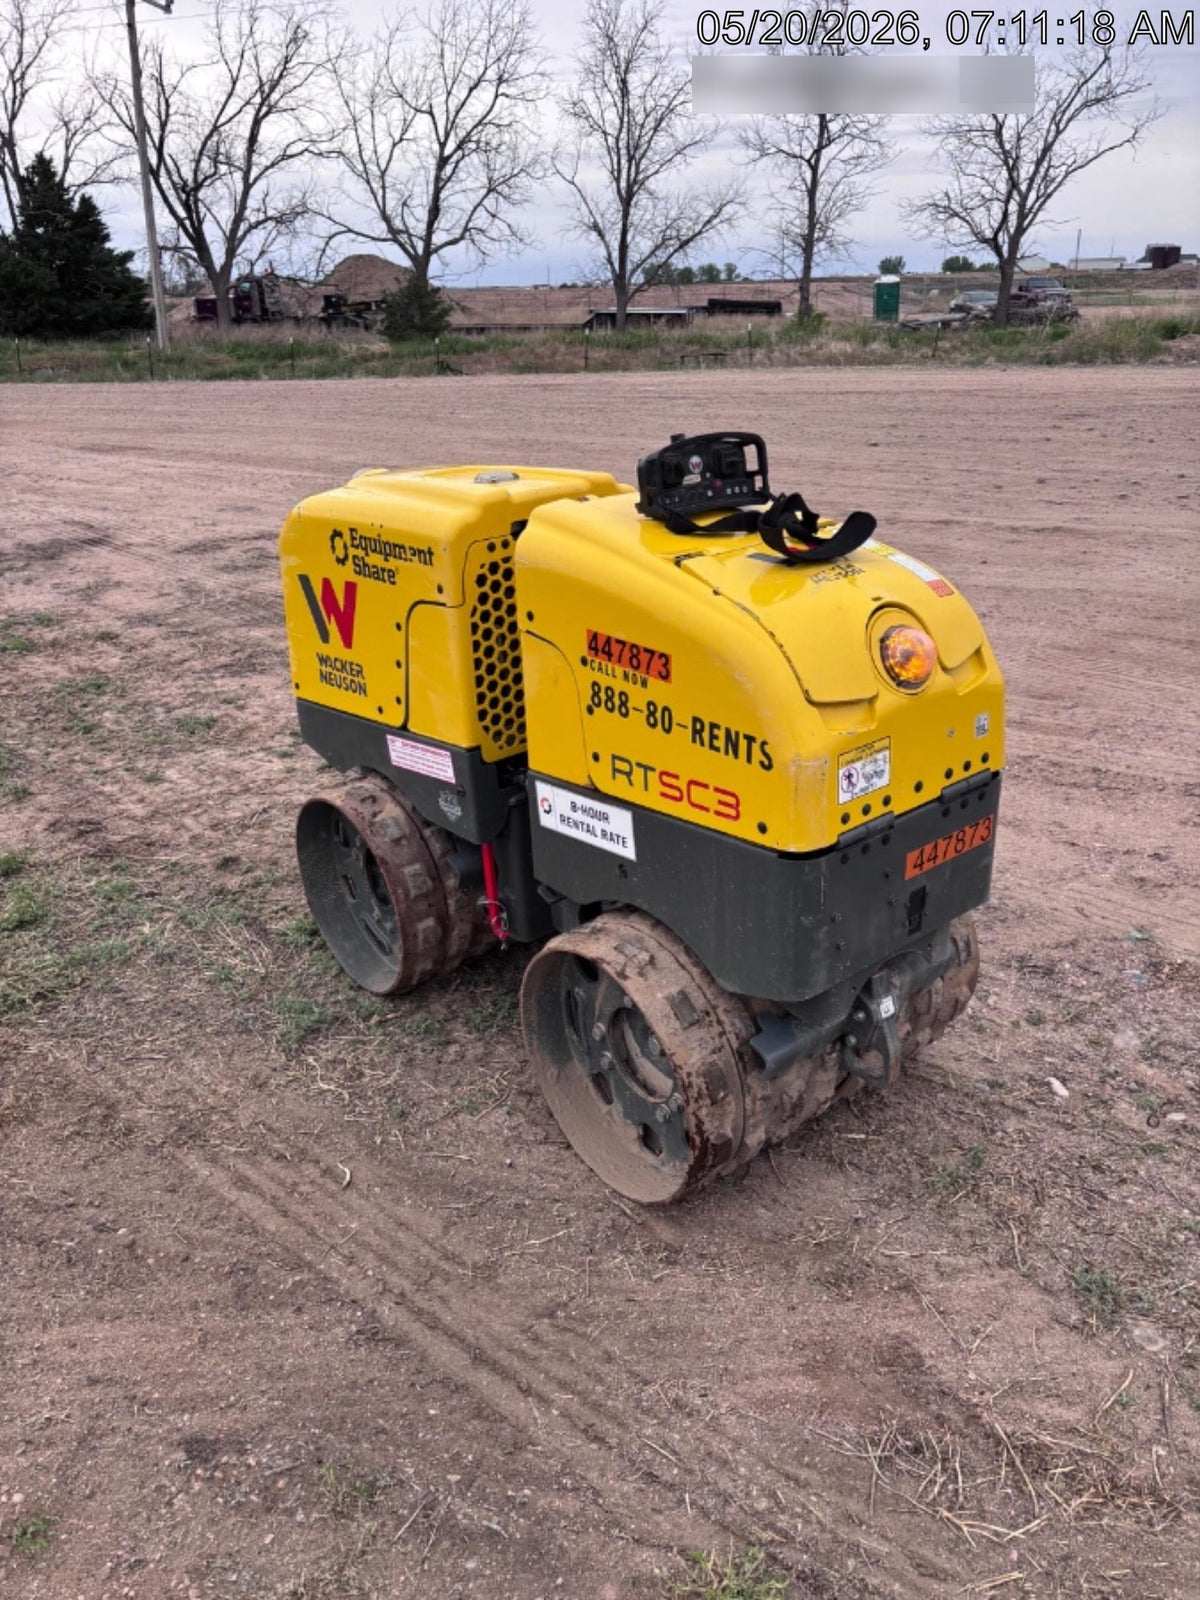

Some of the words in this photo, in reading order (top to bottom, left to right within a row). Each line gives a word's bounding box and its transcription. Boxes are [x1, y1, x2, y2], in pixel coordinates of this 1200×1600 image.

[352, 554, 397, 585] Share
[316, 652, 365, 680] WACKER
[587, 631, 671, 681] 447873
[319, 668, 368, 697] NEUSON
[589, 658, 617, 678] CALL
[623, 669, 649, 689] NOW
[590, 681, 774, 772] 888-80-RENTS
[570, 801, 610, 824] 8-HOUR
[560, 814, 598, 838] RENTAL
[601, 829, 629, 848] RATE
[912, 816, 993, 872] 447873
